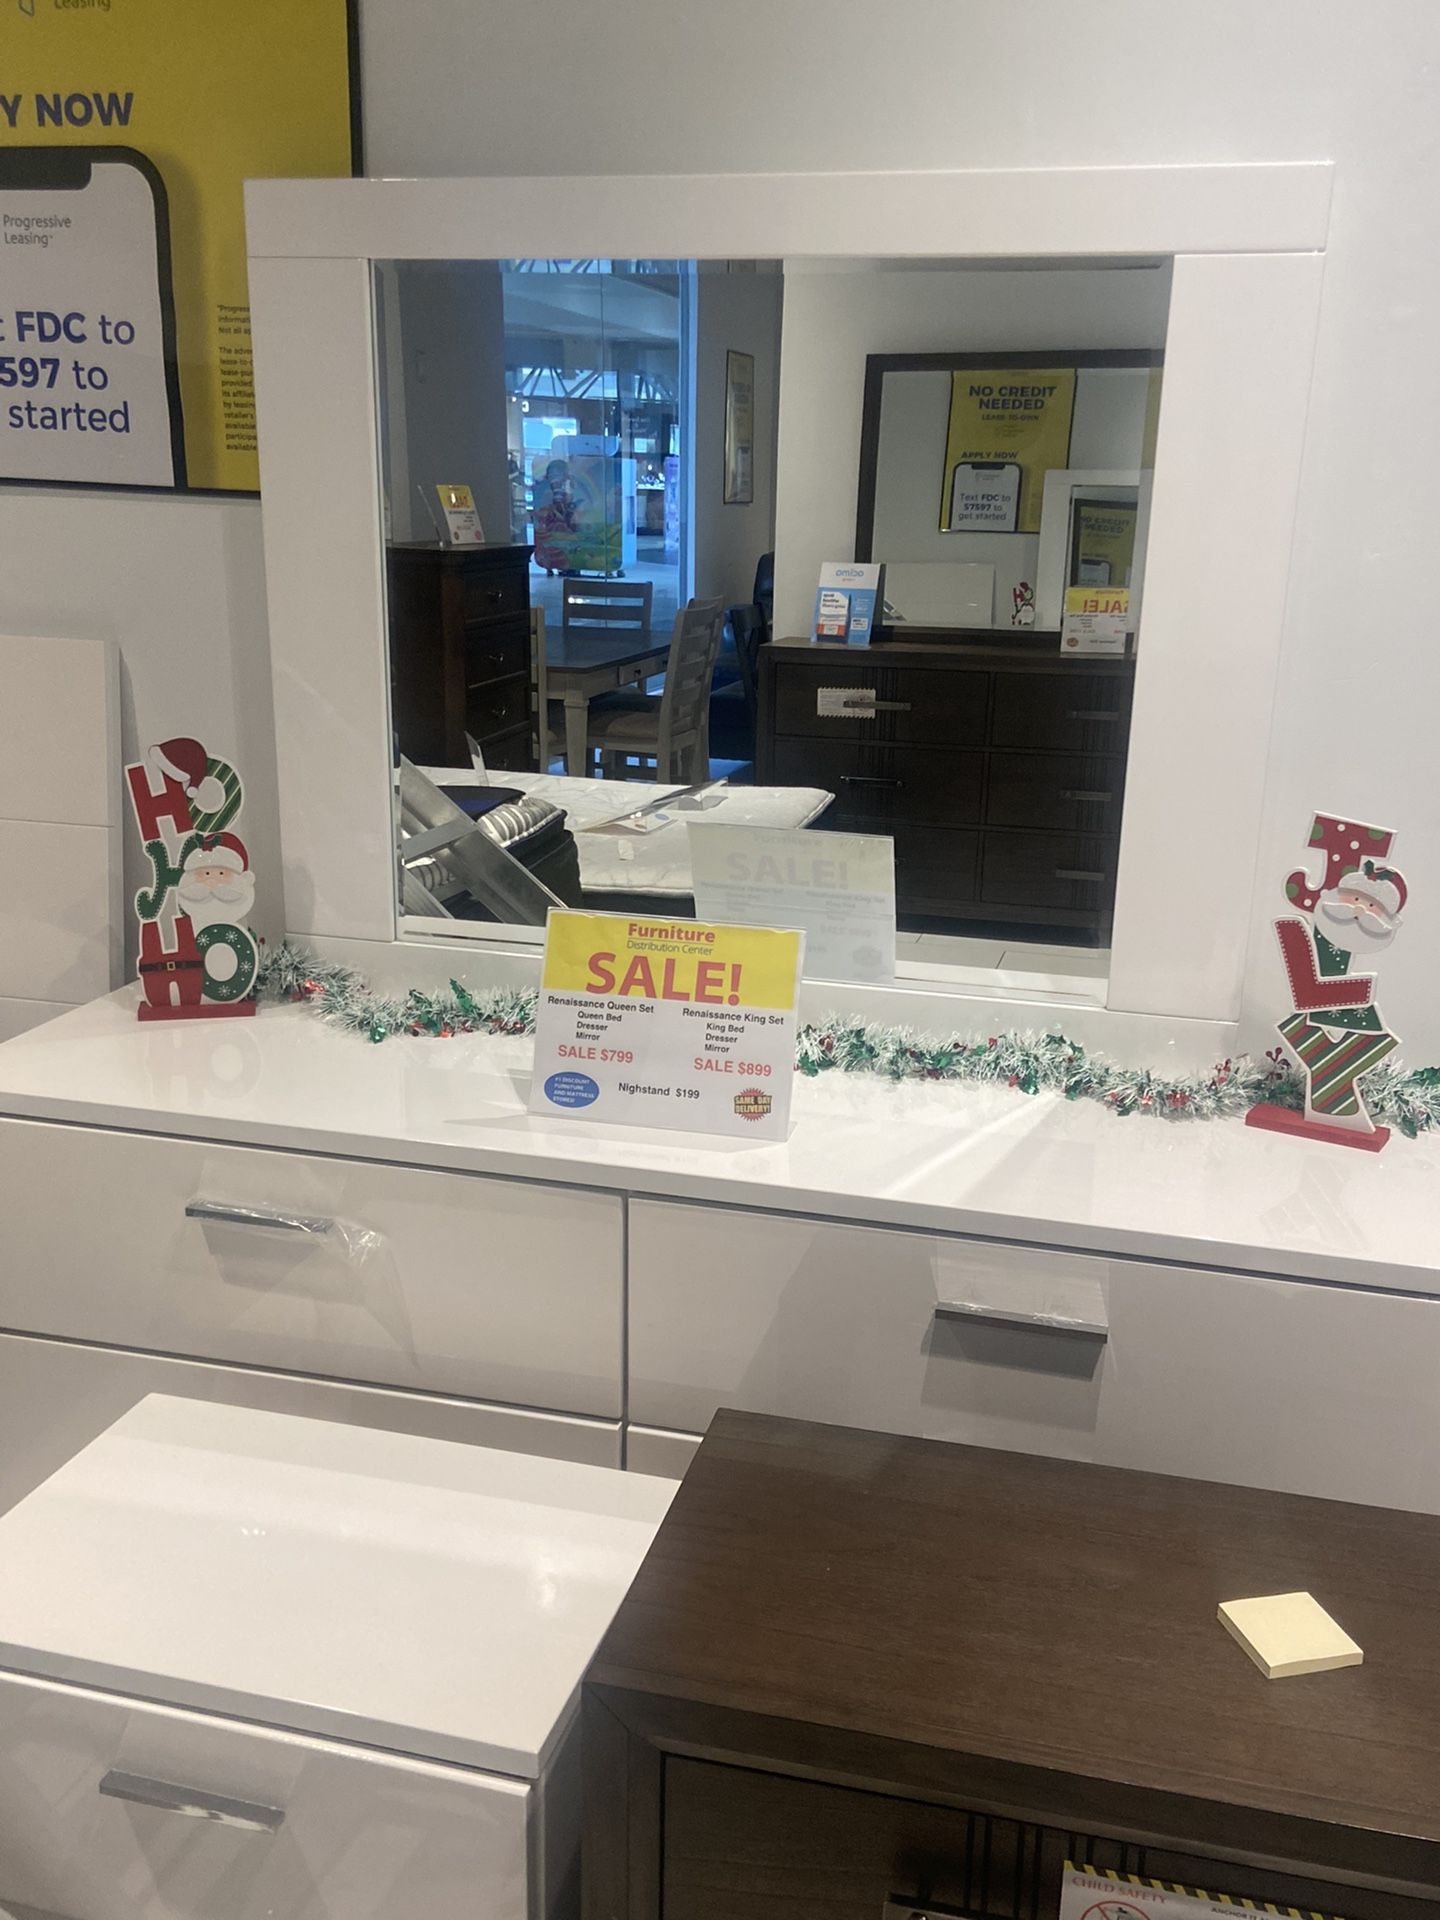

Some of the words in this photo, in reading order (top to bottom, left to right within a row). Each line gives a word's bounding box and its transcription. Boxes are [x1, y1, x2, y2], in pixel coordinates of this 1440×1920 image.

[34, 92, 134, 128] NOW
[3, 214, 72, 231] Progressive
[15, 311, 88, 344] FDC
[98, 314, 135, 345] to
[72, 360, 108, 391] to
[969, 385, 993, 397] NO
[998, 386, 1057, 398] CREDIT
[978, 398, 1045, 410] NEEDED
[8, 400, 130, 434] started
[961, 451, 991, 459] APPLY
[994, 451, 1019, 459] NOW
[960, 493, 978, 502] Text
[981, 493, 999, 502] FDC
[1002, 494, 1011, 502] to
[964, 503, 992, 511] 57597
[958, 513, 973, 521] get
[975, 512, 1008, 521] started
[726, 851, 850, 890] SALE!
[628, 923, 716, 943] Furniture
[626, 940, 680, 953] Distribution
[681, 944, 714, 956] Center
[585, 952, 743, 1006] SALE!
[547, 995, 605, 1009] Renaissance
[606, 1001, 637, 1012] Queen
[638, 1004, 654, 1013] Set
[577, 1010, 604, 1020] Queen
[606, 1013, 622, 1022] Bed
[682, 1008, 742, 1022] Renaissance
[743, 1014, 766, 1026] King
[768, 1014, 784, 1025] Set
[576, 1021, 608, 1031] Dresser
[706, 1022, 726, 1033] King
[727, 1024, 745, 1033] Bed
[575, 1031, 600, 1041] Mirror
[705, 1033, 738, 1043] Dresser
[558, 1044, 597, 1060] SALE
[600, 1048, 633, 1063] $799
[704, 1043, 730, 1053] Mirror
[693, 1057, 734, 1073] SALE
[737, 1061, 772, 1077] $899
[618, 1082, 671, 1097] Nighstand
[675, 1088, 700, 1099] $199
[735, 1096, 755, 1105] SAME
[757, 1096, 770, 1105] DAY
[1072, 1876, 1115, 1893] CHILD
[1119, 1887, 1168, 1904] SAFETY
